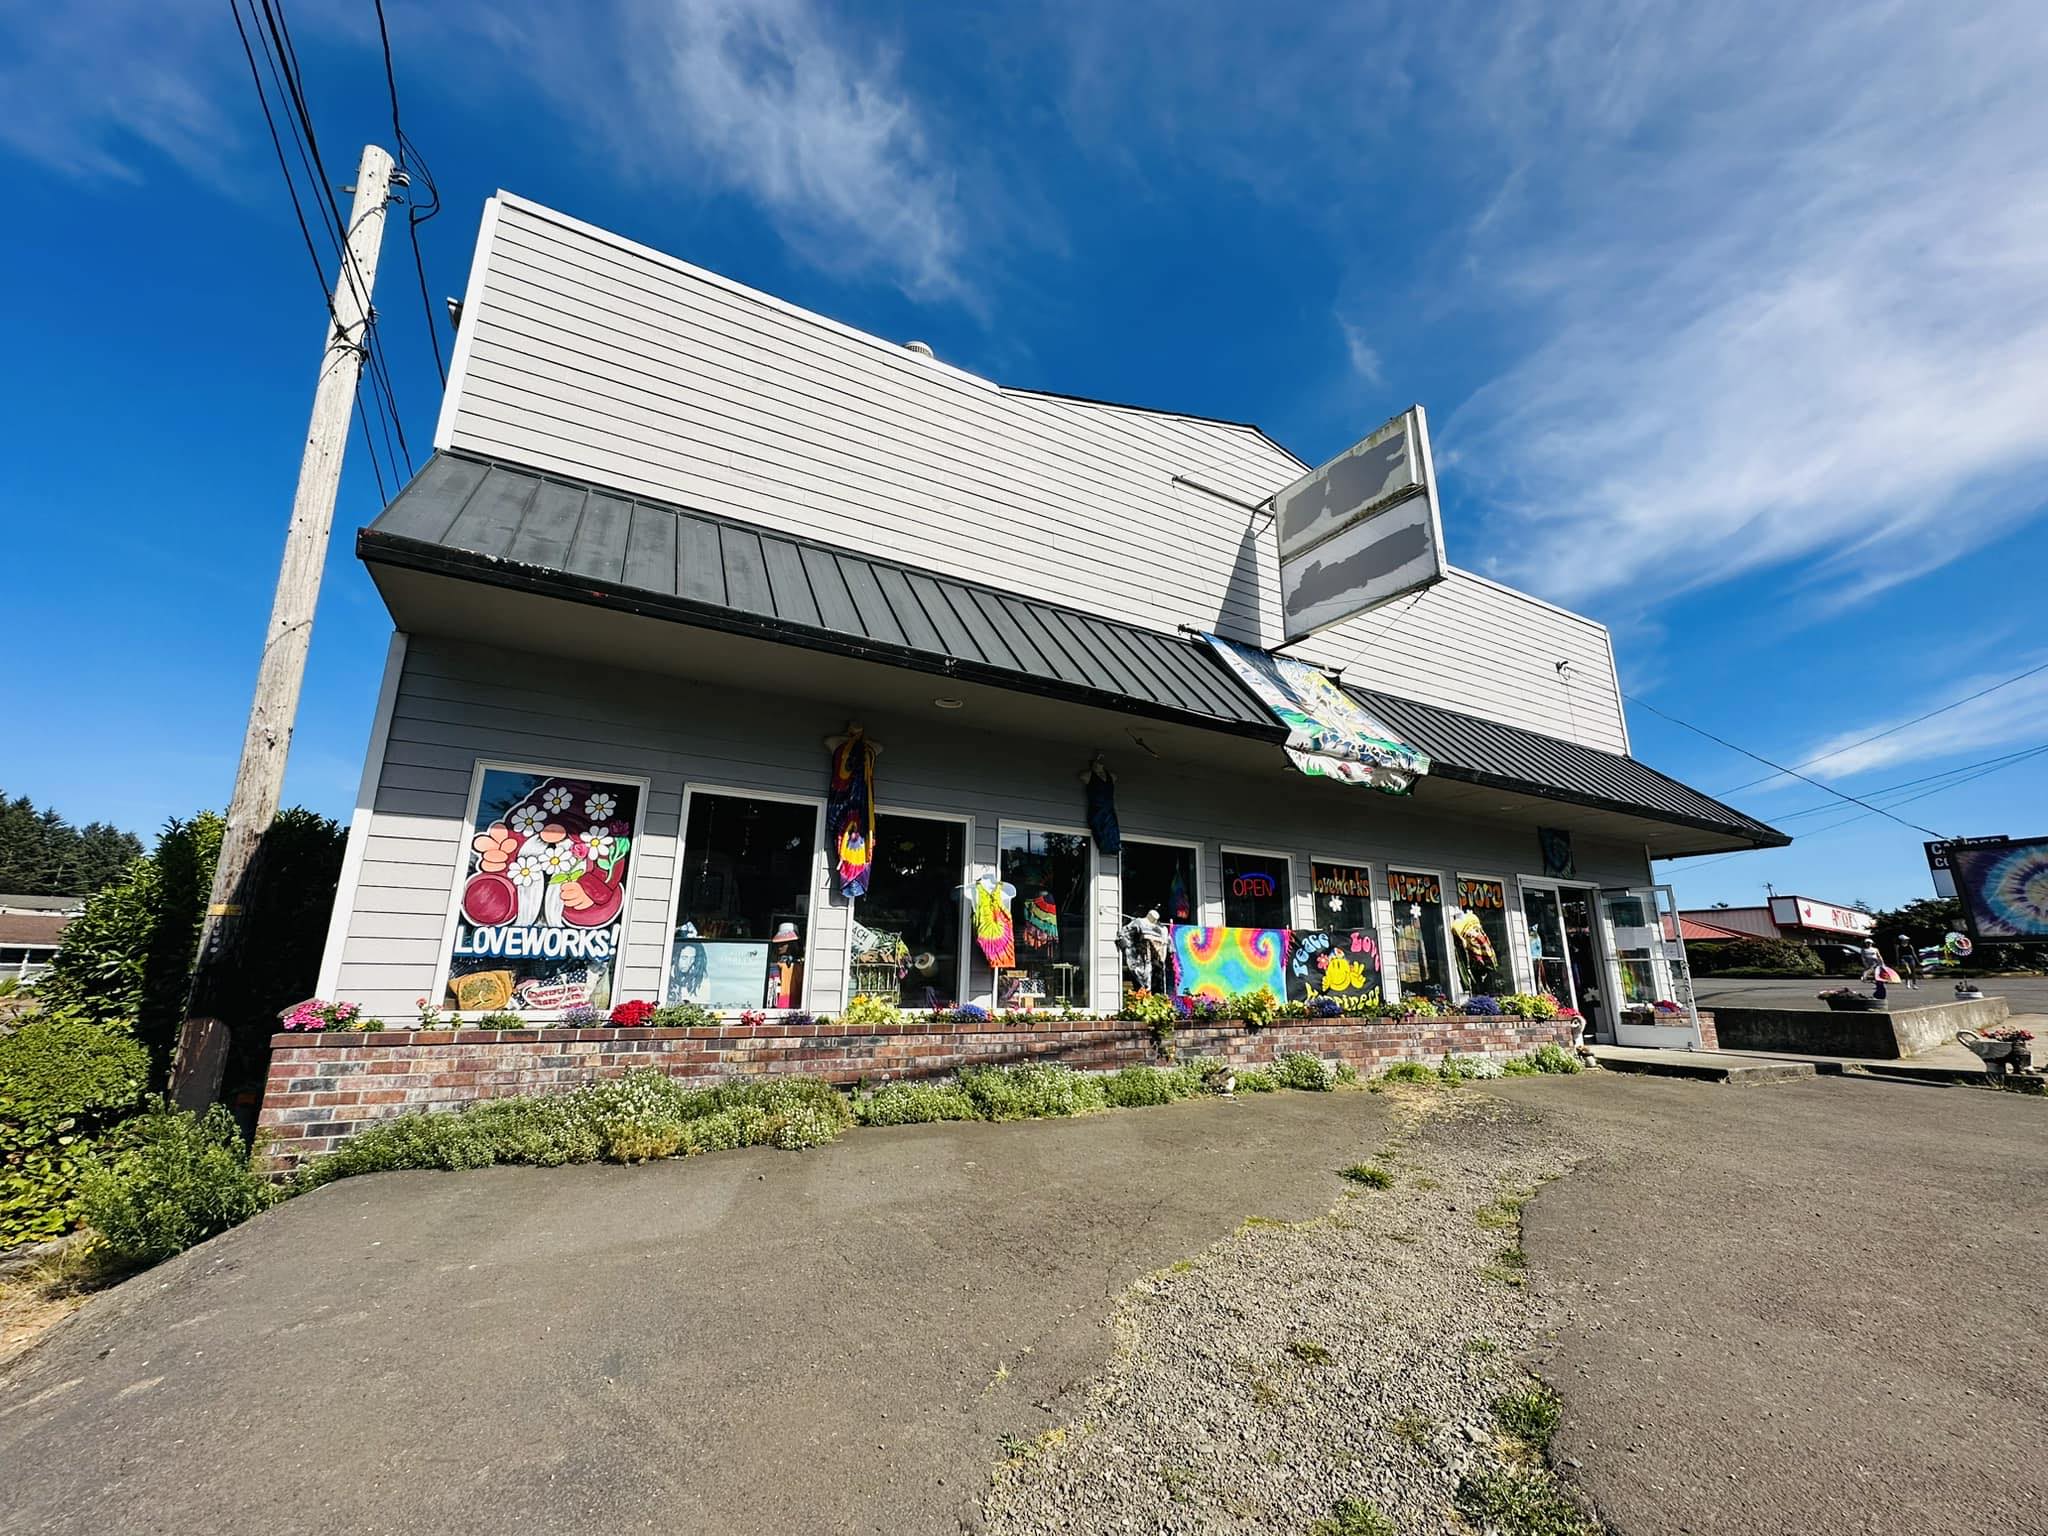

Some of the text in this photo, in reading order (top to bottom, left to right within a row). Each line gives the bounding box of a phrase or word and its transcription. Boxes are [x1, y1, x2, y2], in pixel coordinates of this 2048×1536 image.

[1232, 878, 1273, 897] OPEN
[454, 923, 621, 958] LOVEWORKS!
[1292, 932, 1330, 978] Peace
